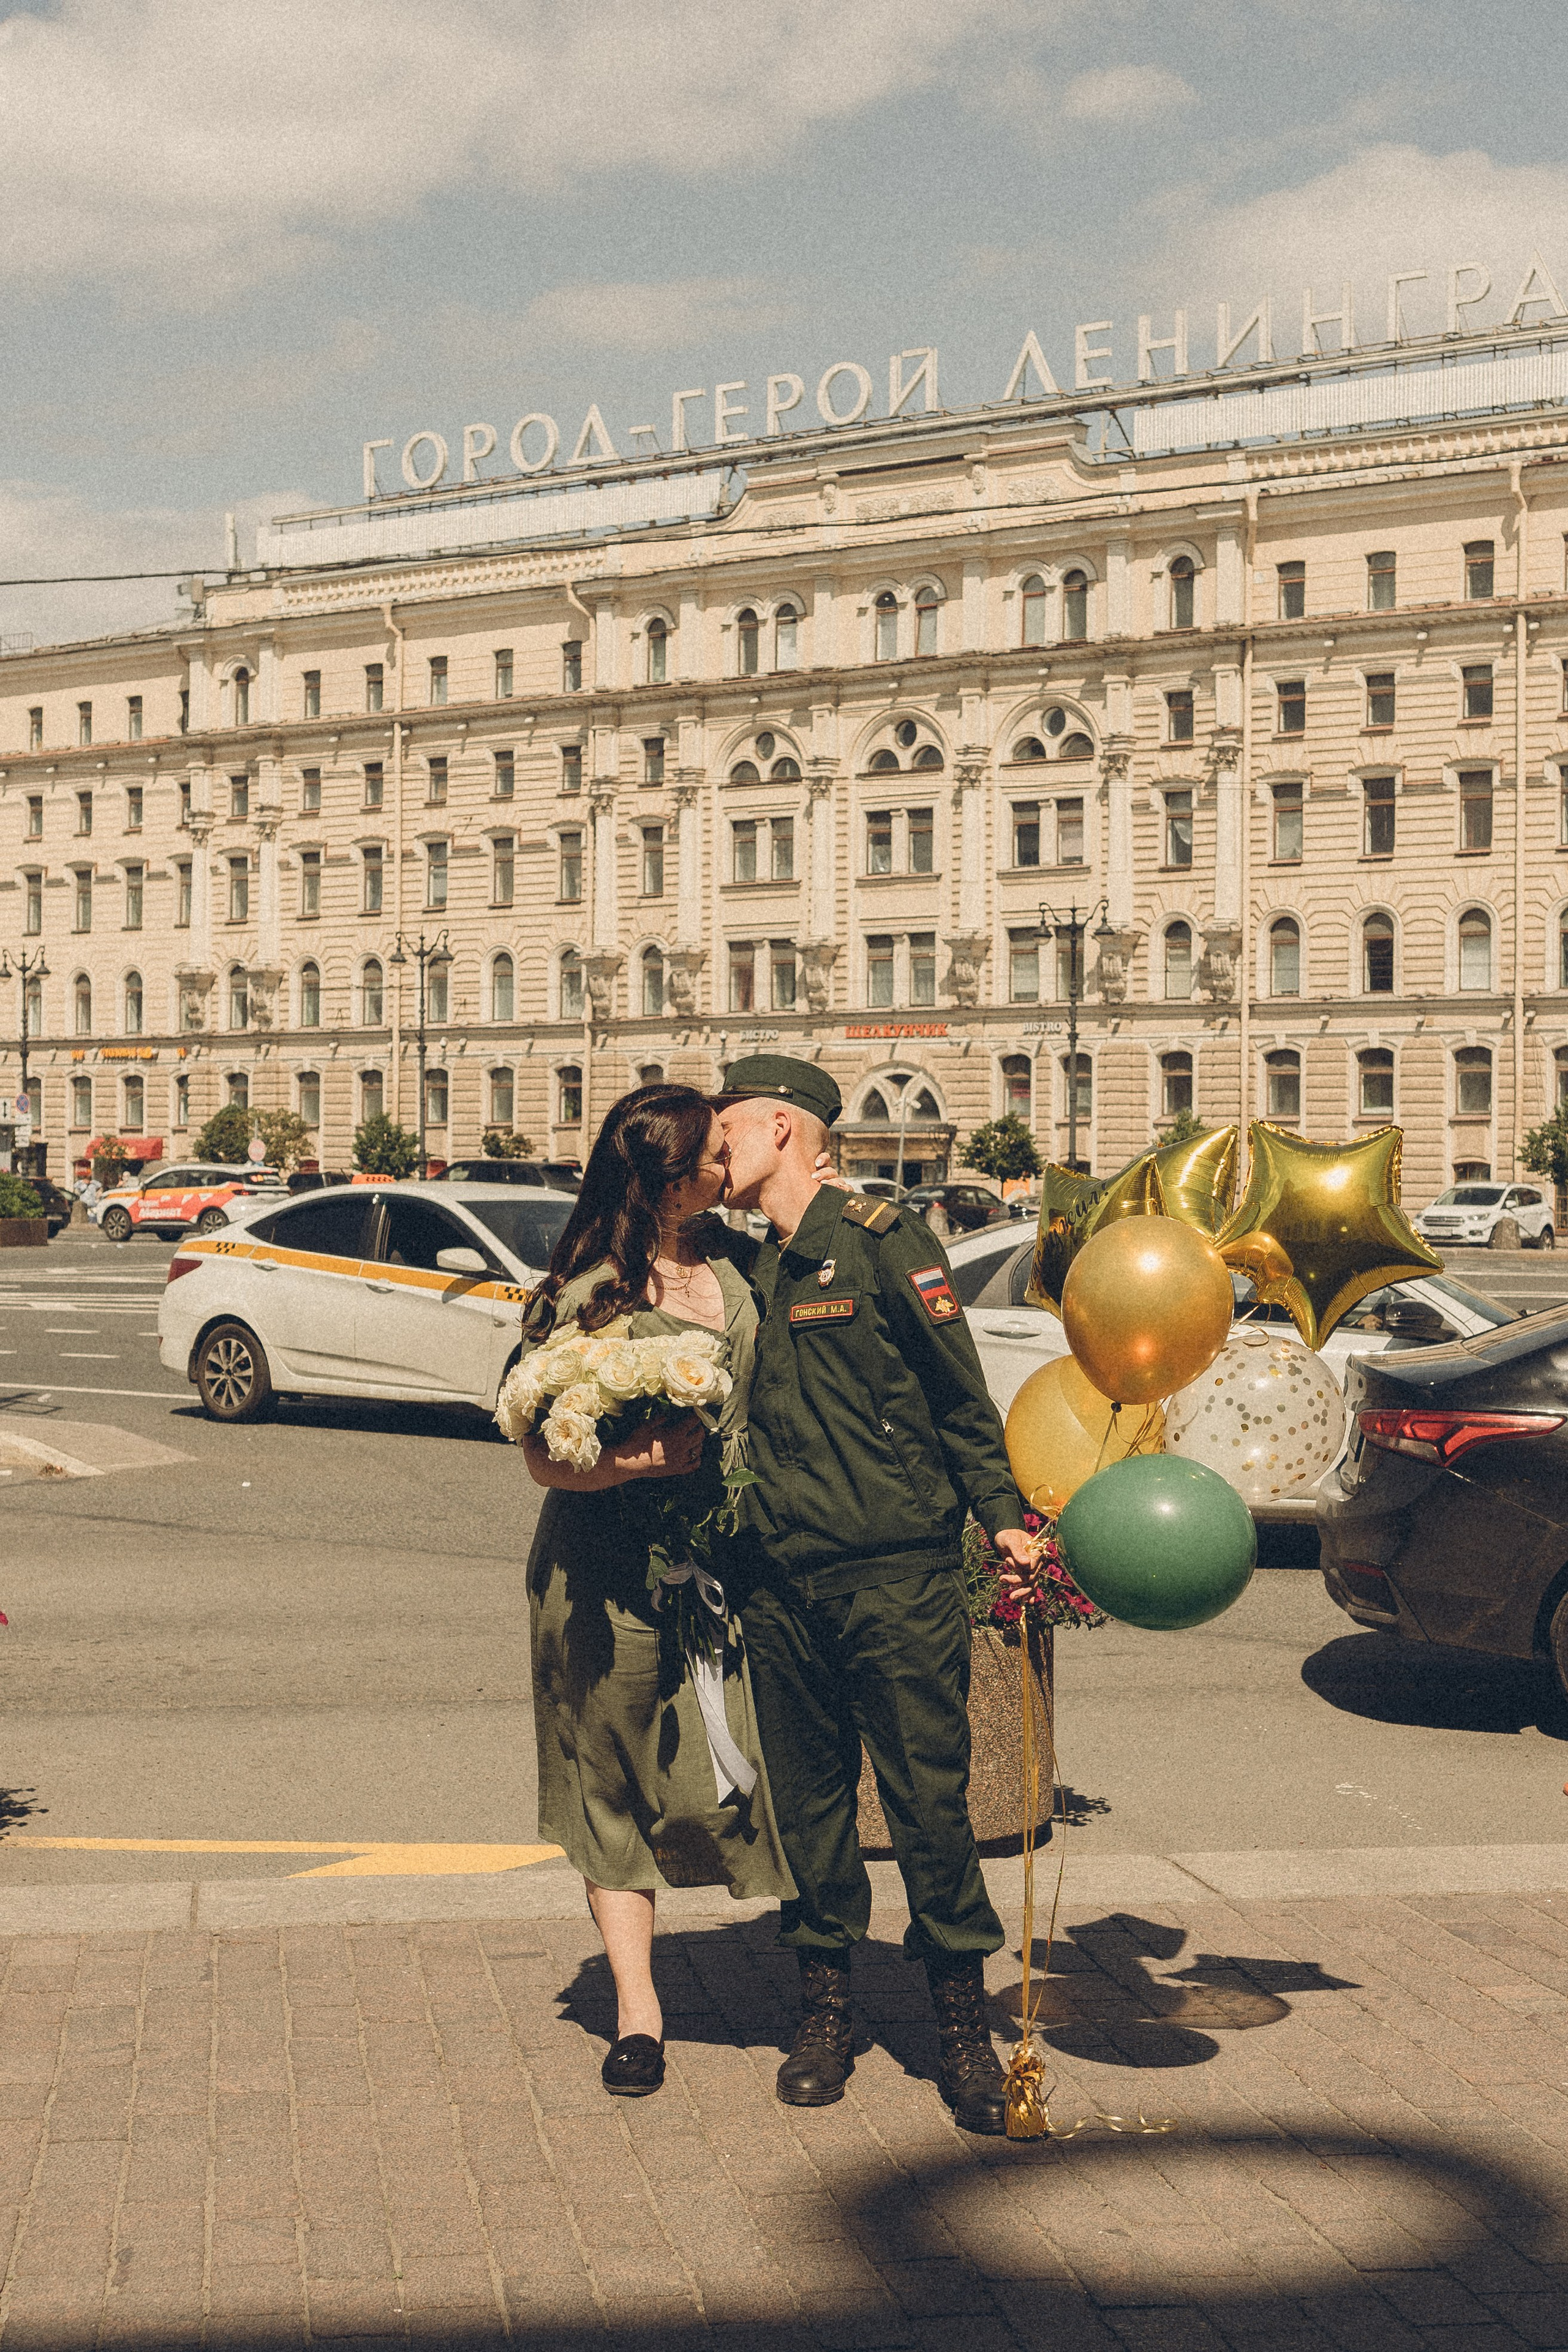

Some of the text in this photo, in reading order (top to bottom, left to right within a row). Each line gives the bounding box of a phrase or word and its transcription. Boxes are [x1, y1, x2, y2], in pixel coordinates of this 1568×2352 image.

[363, 249, 1568, 497] ГОРОД-ГЕРОЙ ЛЕНИНГРА
[1023, 1022, 1063, 1033] BISTRO
[740, 1029, 780, 1041] БИСТРО
[795, 1305, 847, 1317] ГОНСКИЙ М.А.
